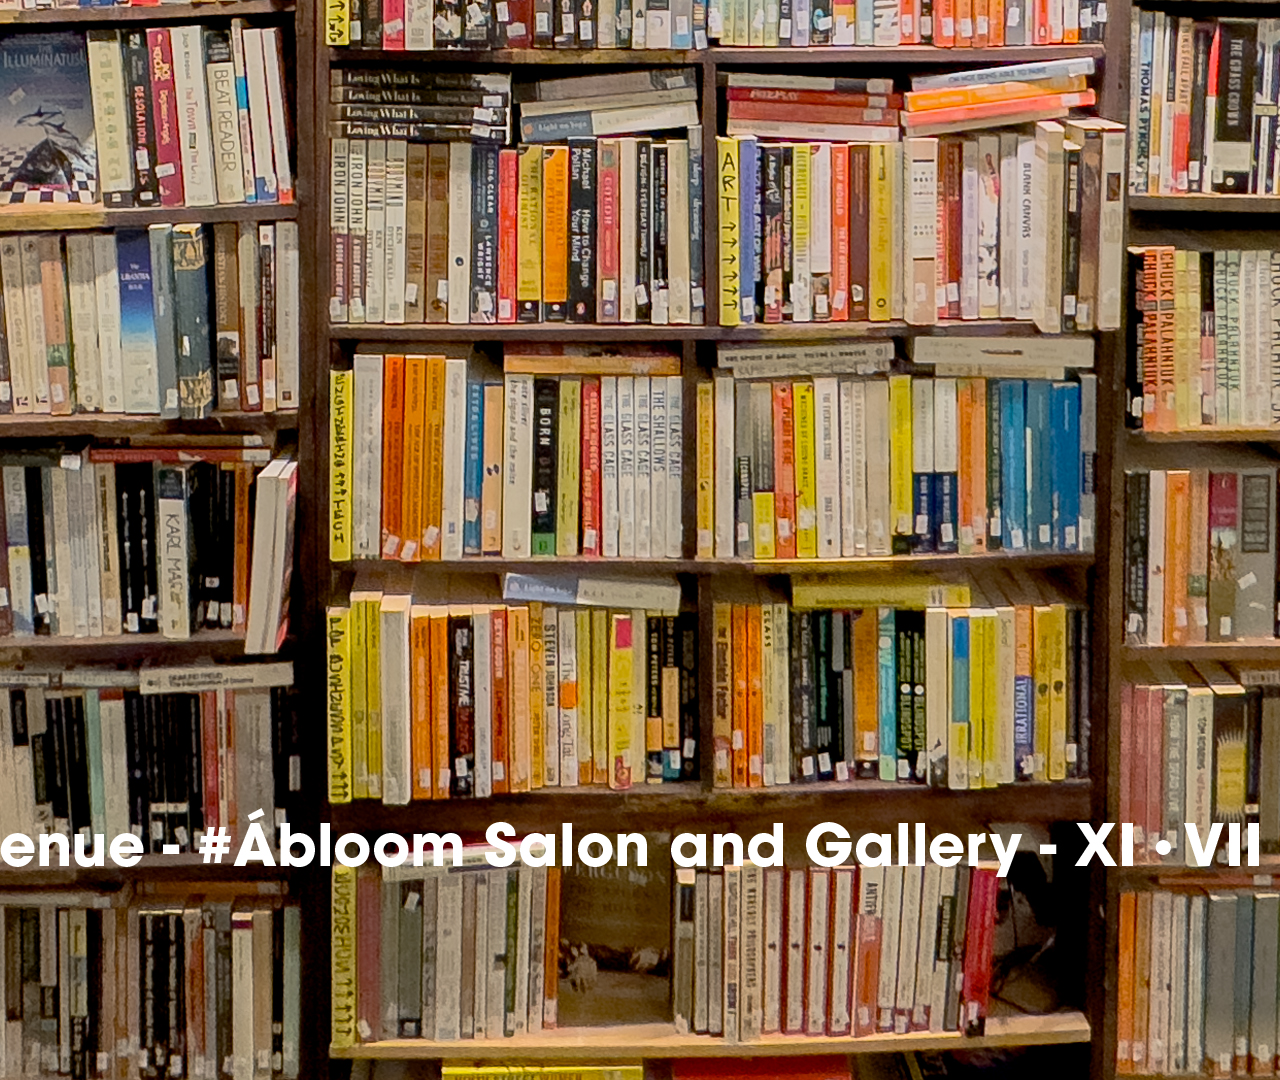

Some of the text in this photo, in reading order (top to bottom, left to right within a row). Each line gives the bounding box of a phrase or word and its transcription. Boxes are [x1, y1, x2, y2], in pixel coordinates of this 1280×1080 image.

[213, 69, 237, 171] BEAT READER
[1140, 62, 1151, 113] THOMAS
[333, 155, 345, 223] IRON JOHN
[351, 157, 363, 225] IRON JOHN
[572, 147, 581, 181] Pollan
[581, 147, 591, 190] Michael
[722, 152, 736, 210] ART
[581, 209, 590, 228] How
[1021, 163, 1033, 238] BLANK CANVAS
[572, 209, 581, 262] Your Mind
[579, 240, 590, 288] Change
[1143, 254, 1157, 387] CHUCK PALAHNIUK
[1160, 253, 1174, 386] CHUCK PALAHNIUK
[1216, 261, 1227, 390] CHUCK PALAHNIUK
[1227, 261, 1239, 390] CHUCK PALAHNIUK
[540, 407, 552, 446] BORN
[652, 390, 666, 473] THE SHALLOWS
[544, 623, 556, 707] STEVEN JOHNSON
[716, 642, 730, 719] Einstein Factor
[1014, 678, 1030, 745] IRRATIONAL
